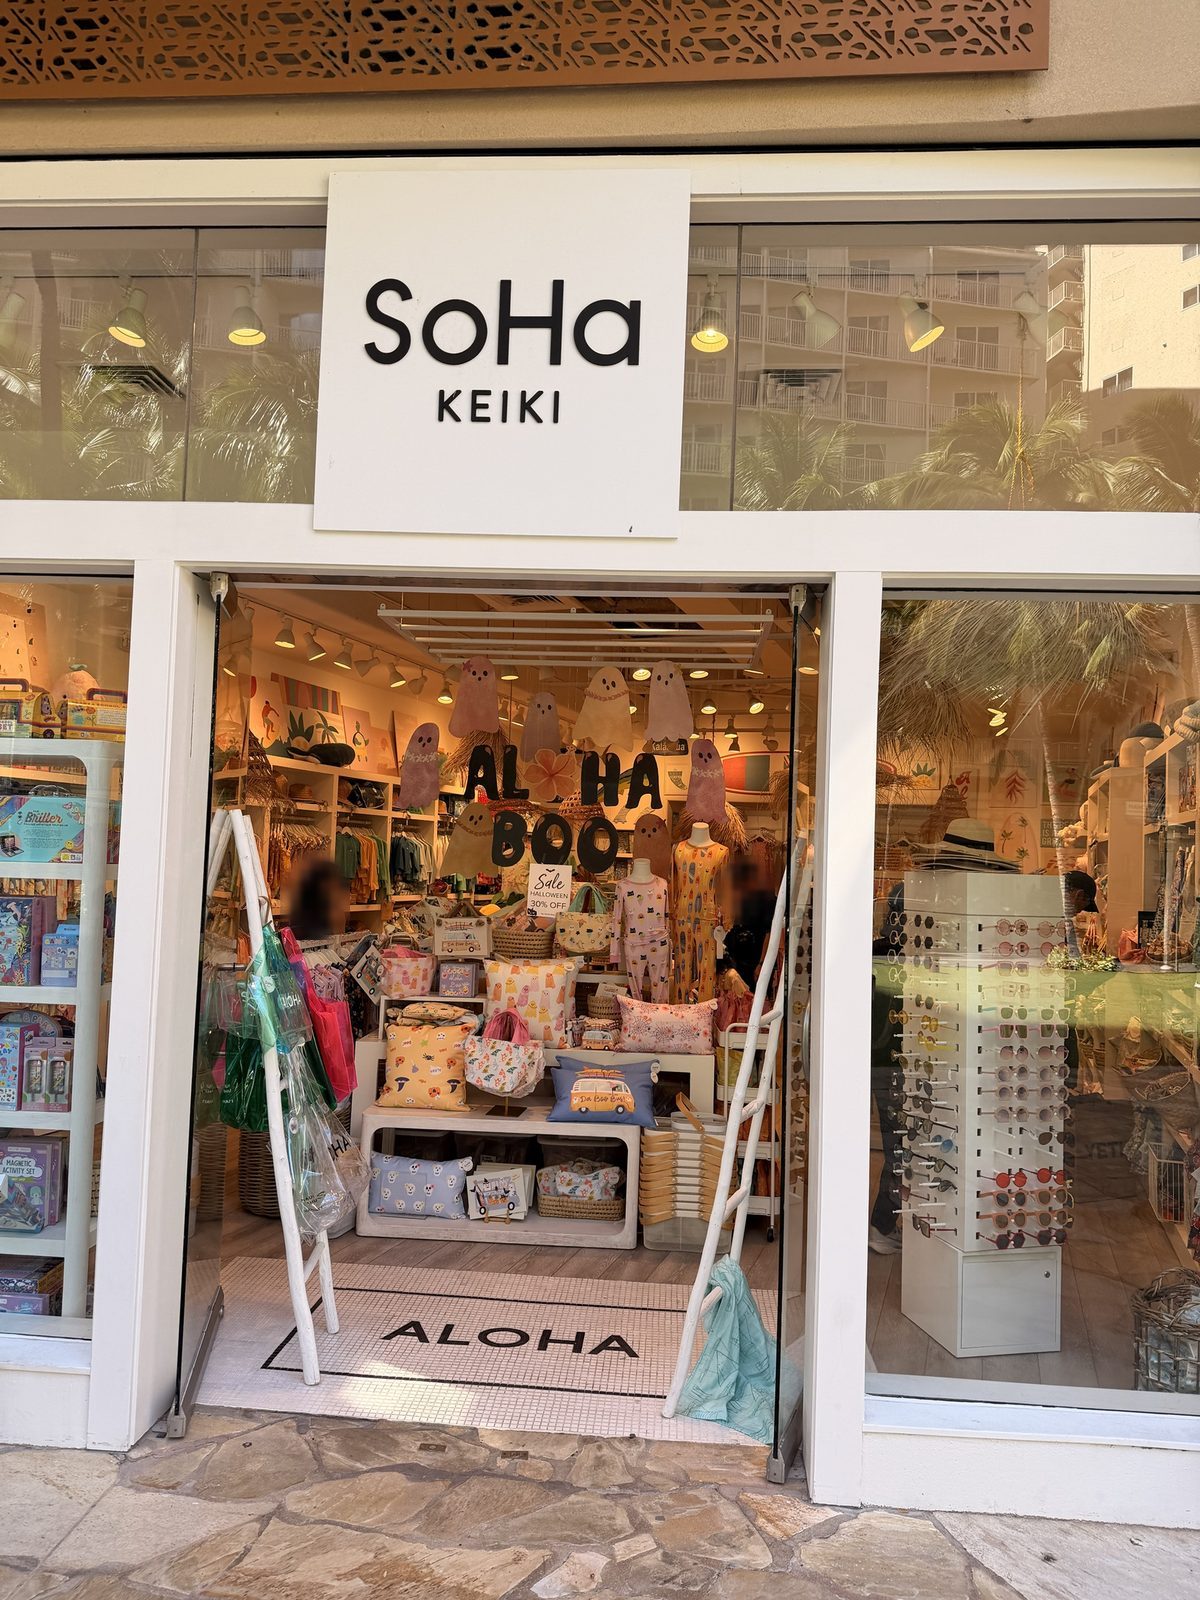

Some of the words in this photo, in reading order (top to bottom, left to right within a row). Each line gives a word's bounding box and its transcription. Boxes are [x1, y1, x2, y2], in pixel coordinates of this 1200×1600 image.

[364, 278, 641, 366] SoHa
[437, 389, 560, 424] KEIKI
[491, 809, 619, 874] BOO
[534, 872, 566, 890] Sale
[530, 891, 569, 899] HALLOWEEN
[530, 899, 548, 908] 30%
[549, 901, 567, 909] OFF
[6, 1159, 32, 1167] MAGNETIC
[380, 1320, 640, 1358] ALOHA
